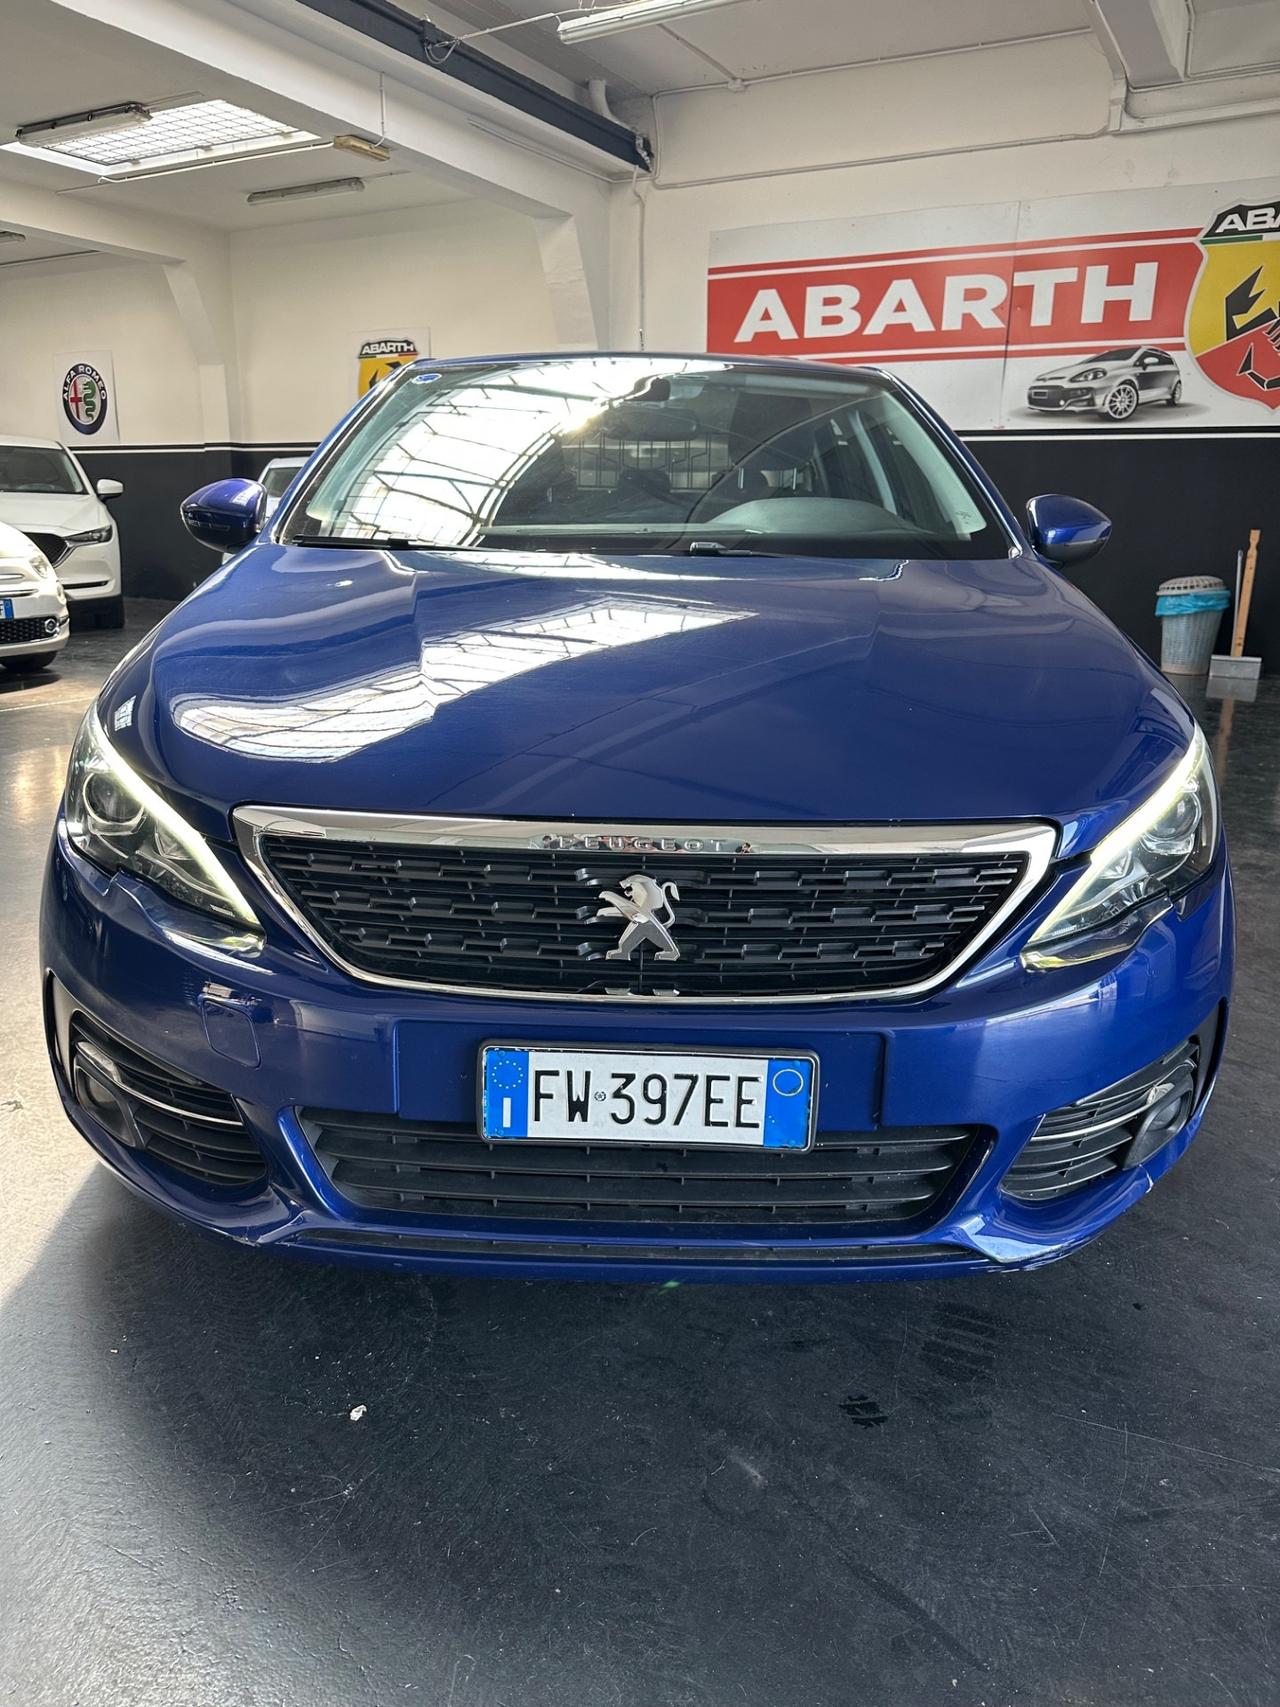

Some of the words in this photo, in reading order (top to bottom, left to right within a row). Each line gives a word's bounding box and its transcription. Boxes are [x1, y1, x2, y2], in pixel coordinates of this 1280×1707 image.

[733, 262, 1159, 343] ABARTH
[362, 342, 414, 354] ABARTH
[63, 370, 76, 400] ALFA
[78, 365, 107, 400] ROMEO
[559, 835, 722, 852] PEUGEOT
